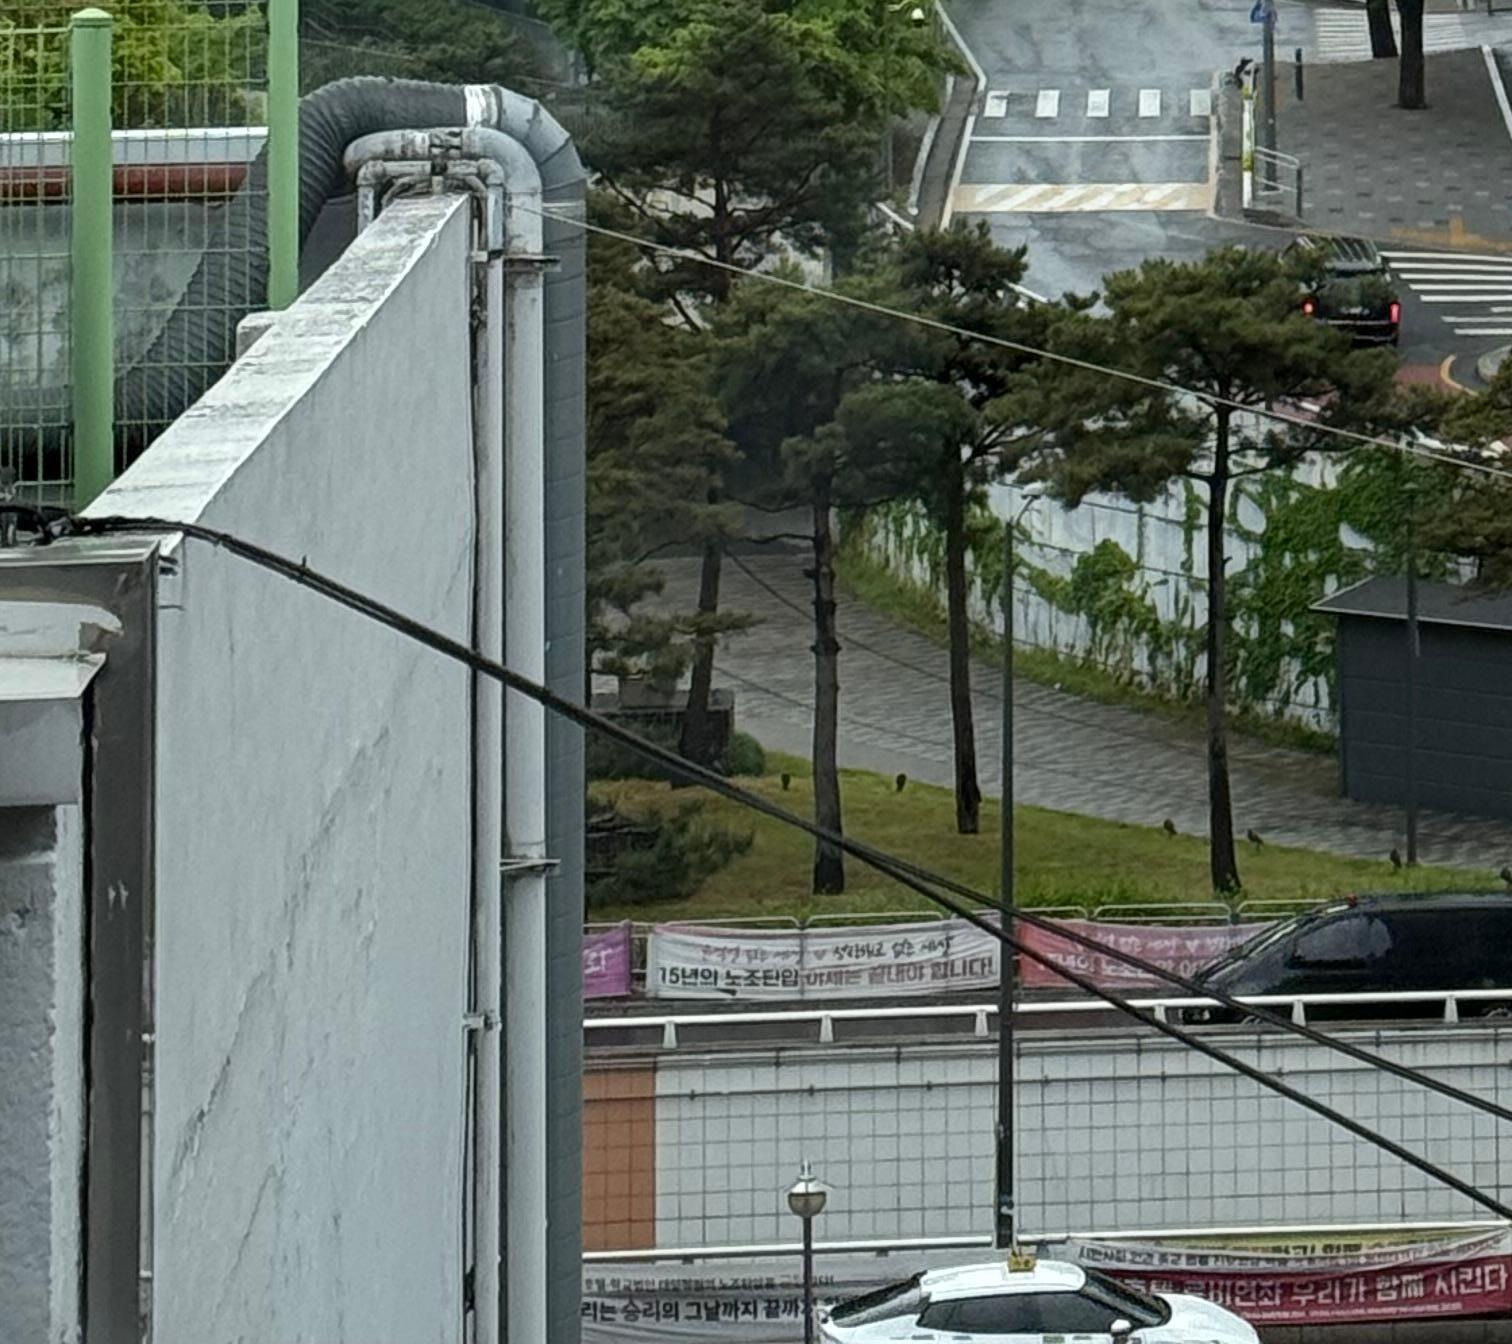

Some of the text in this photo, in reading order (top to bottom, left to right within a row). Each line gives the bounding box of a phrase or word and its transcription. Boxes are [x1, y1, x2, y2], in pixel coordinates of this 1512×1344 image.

[659, 966, 718, 986] 15년의
[724, 967, 798, 987] 노조탄압
[869, 964, 927, 984] 끝내야
[931, 957, 993, 980] 합니다!
[1292, 1276, 1367, 1307] 우리가
[1376, 1272, 1424, 1301] 함께
[621, 1298, 679, 1322] 승리의
[683, 1300, 758, 1322] 그날까지
